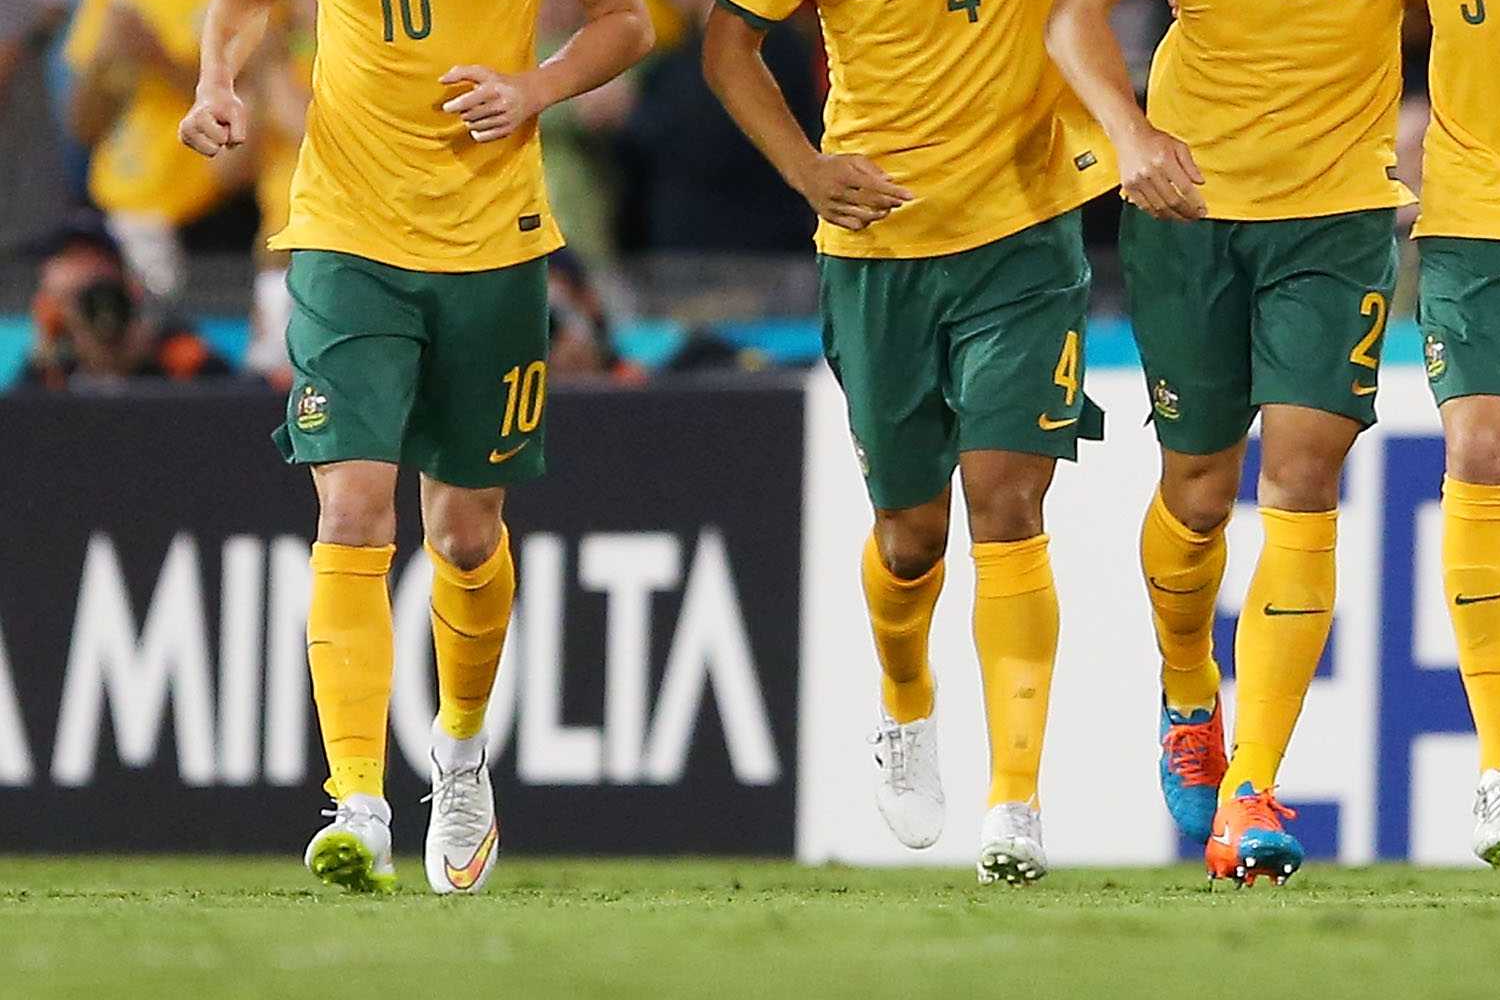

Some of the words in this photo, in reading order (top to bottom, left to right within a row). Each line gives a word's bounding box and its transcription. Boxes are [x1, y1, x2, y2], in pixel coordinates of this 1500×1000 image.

[1053, 330, 1078, 406] 4
[1349, 291, 1386, 370] 2
[500, 360, 547, 437] 10
